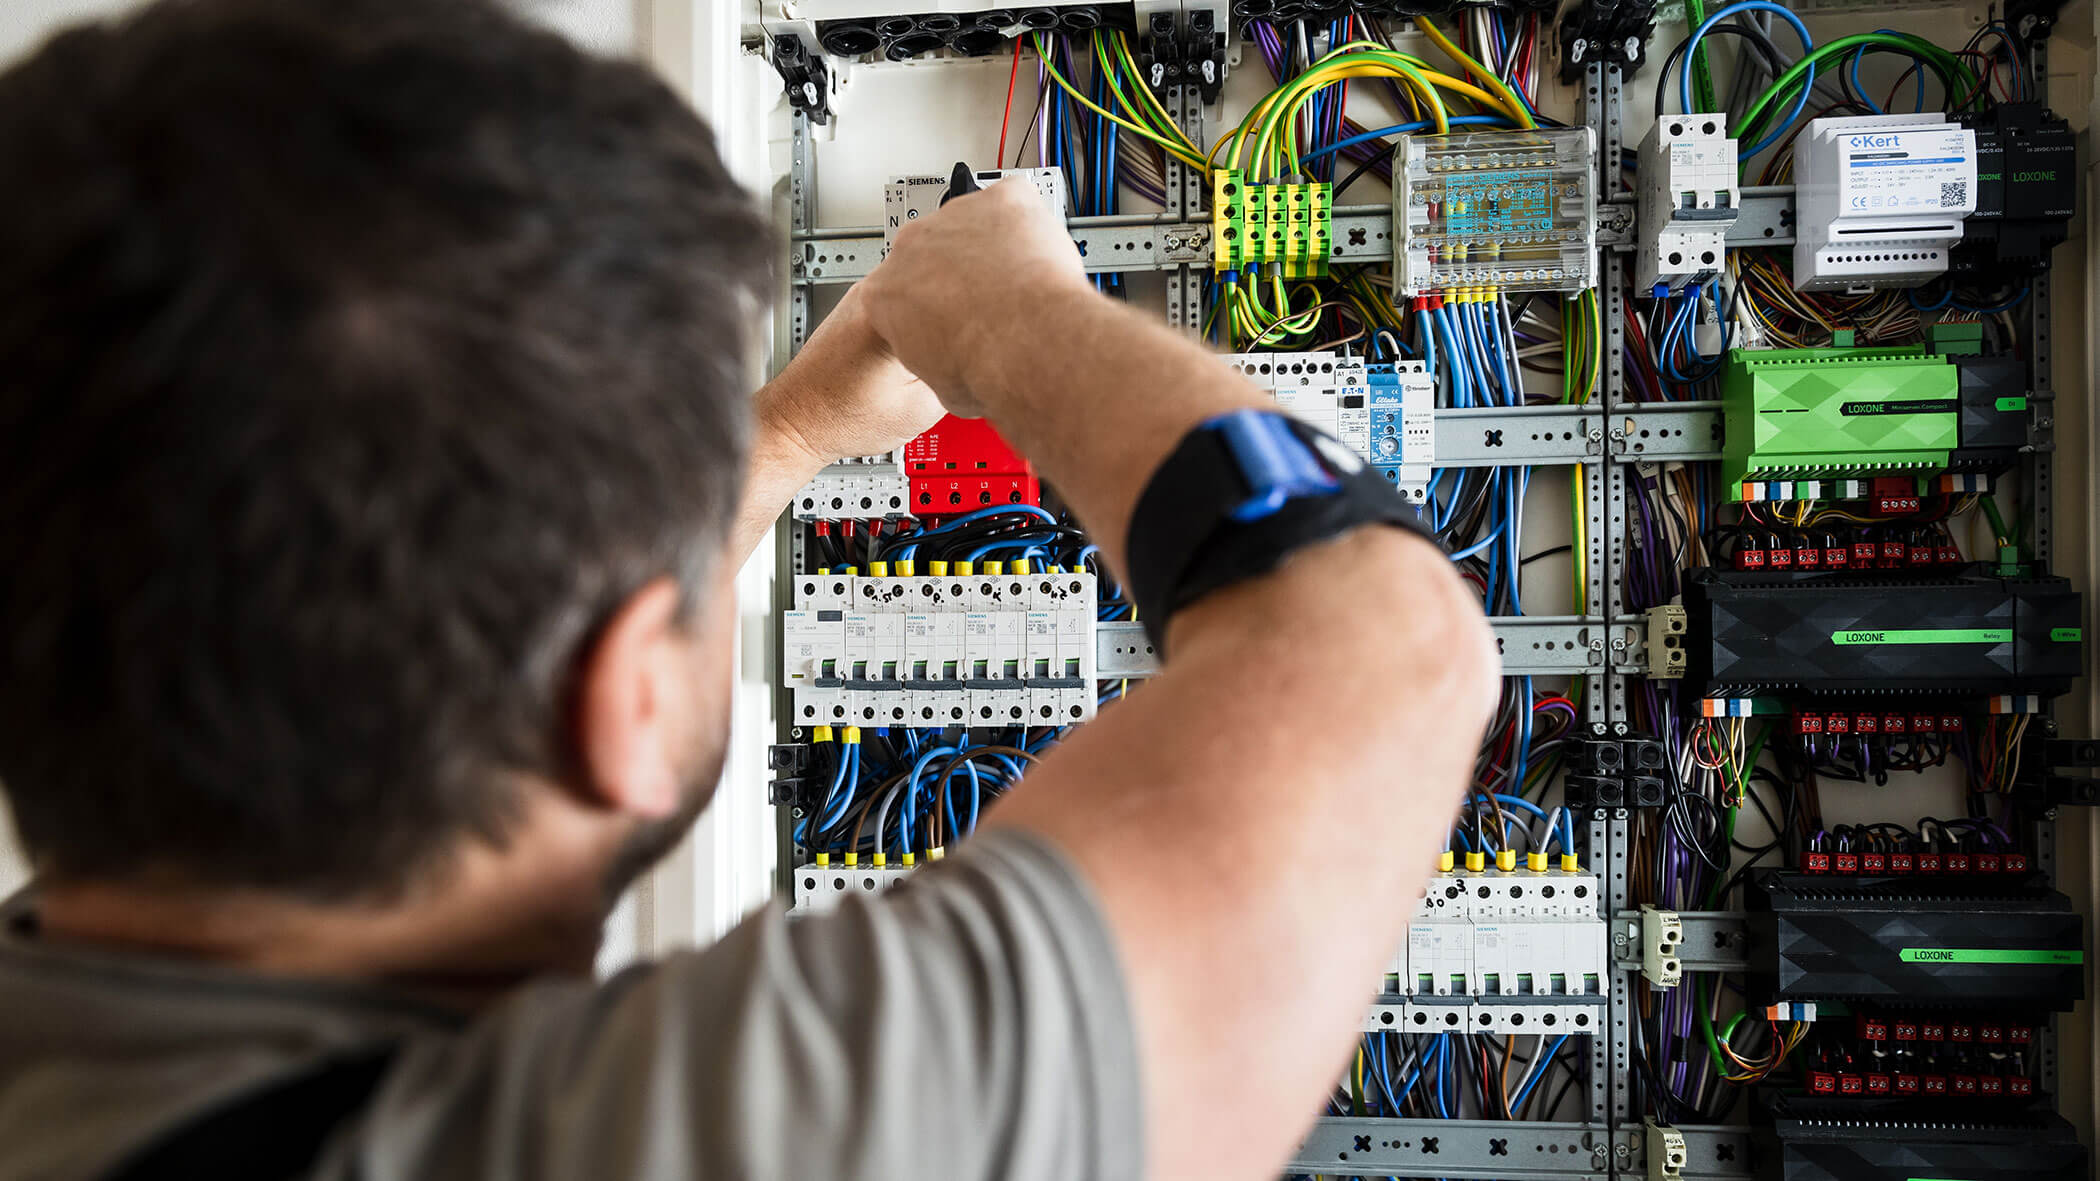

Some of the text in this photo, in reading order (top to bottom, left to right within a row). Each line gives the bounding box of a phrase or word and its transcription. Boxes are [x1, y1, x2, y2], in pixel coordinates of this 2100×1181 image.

[1863, 135, 1900, 147] Kert
[908, 177, 946, 186] SIEMENS
[1977, 173, 2001, 181] OXONE
[2013, 171, 2056, 182] LOXONE
[889, 216, 899, 228] N
[1848, 404, 1885, 413] LOXONE
[981, 481, 989, 489] L3
[1845, 632, 1885, 642] LOXONE
[1914, 950, 1954, 961] LOXONE
